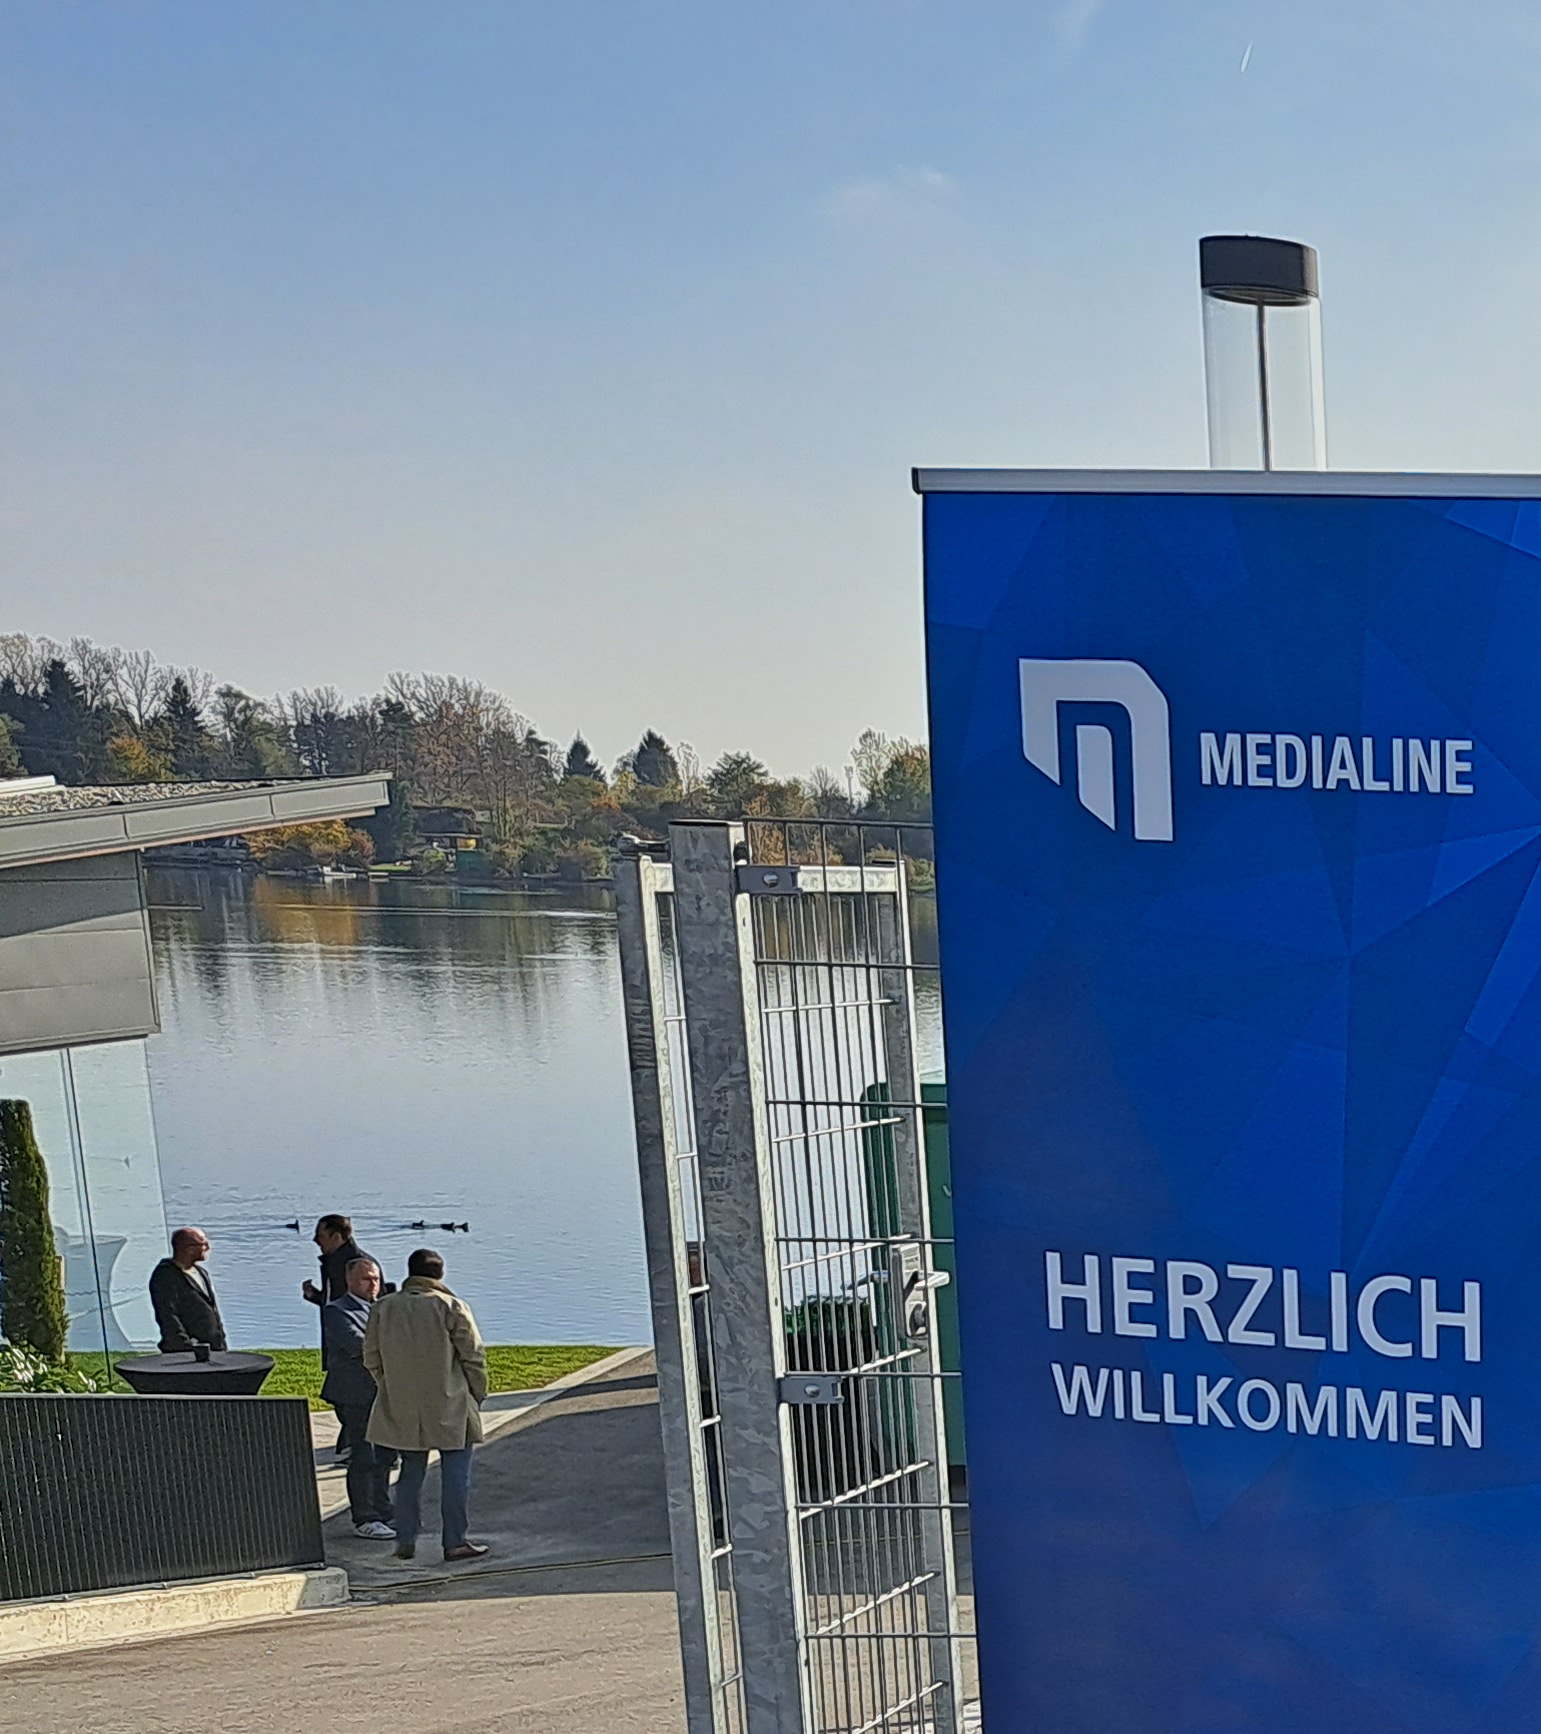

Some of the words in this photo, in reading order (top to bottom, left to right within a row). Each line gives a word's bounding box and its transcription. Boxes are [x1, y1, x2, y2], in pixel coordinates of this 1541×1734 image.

[1199, 731, 1475, 795] MEDIALINE
[1044, 1250, 1482, 1363] HERZLICH
[1050, 1362, 1483, 1449] WILLKOMMEN
